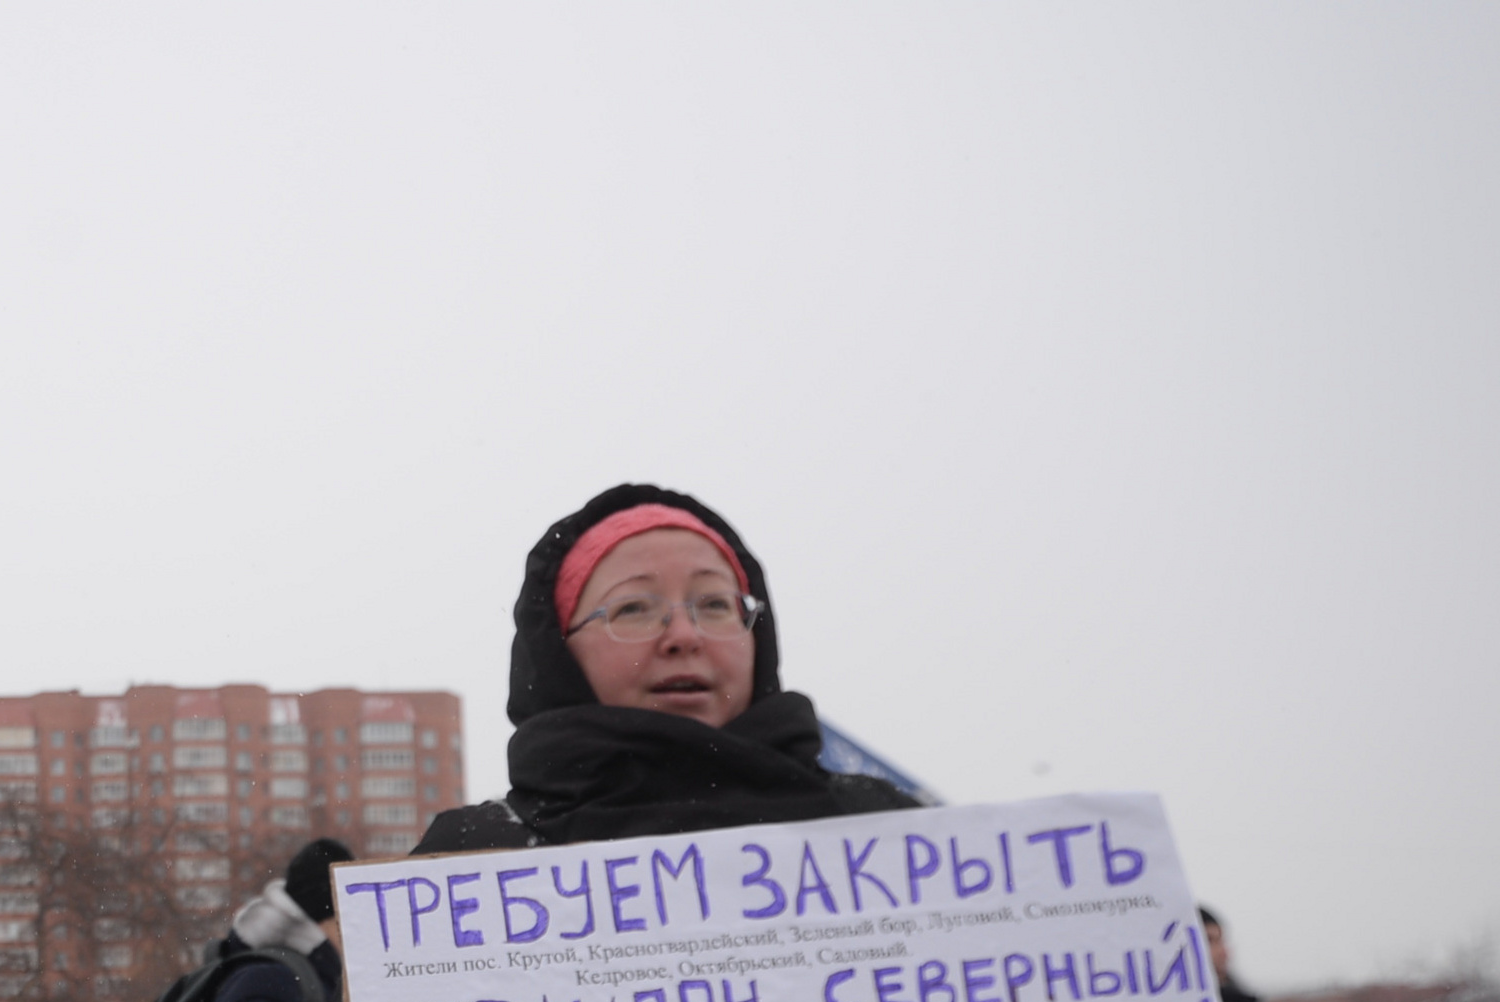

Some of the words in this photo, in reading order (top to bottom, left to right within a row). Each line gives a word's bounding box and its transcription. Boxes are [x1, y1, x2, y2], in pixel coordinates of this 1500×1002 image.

[346, 843, 710, 951] ТРЕБУЕМ
[741, 821, 1146, 919] ЗАКРЫТЬ
[383, 961, 457, 978] Жители
[463, 956, 501, 972] пос.
[508, 947, 583, 972] Крутой,
